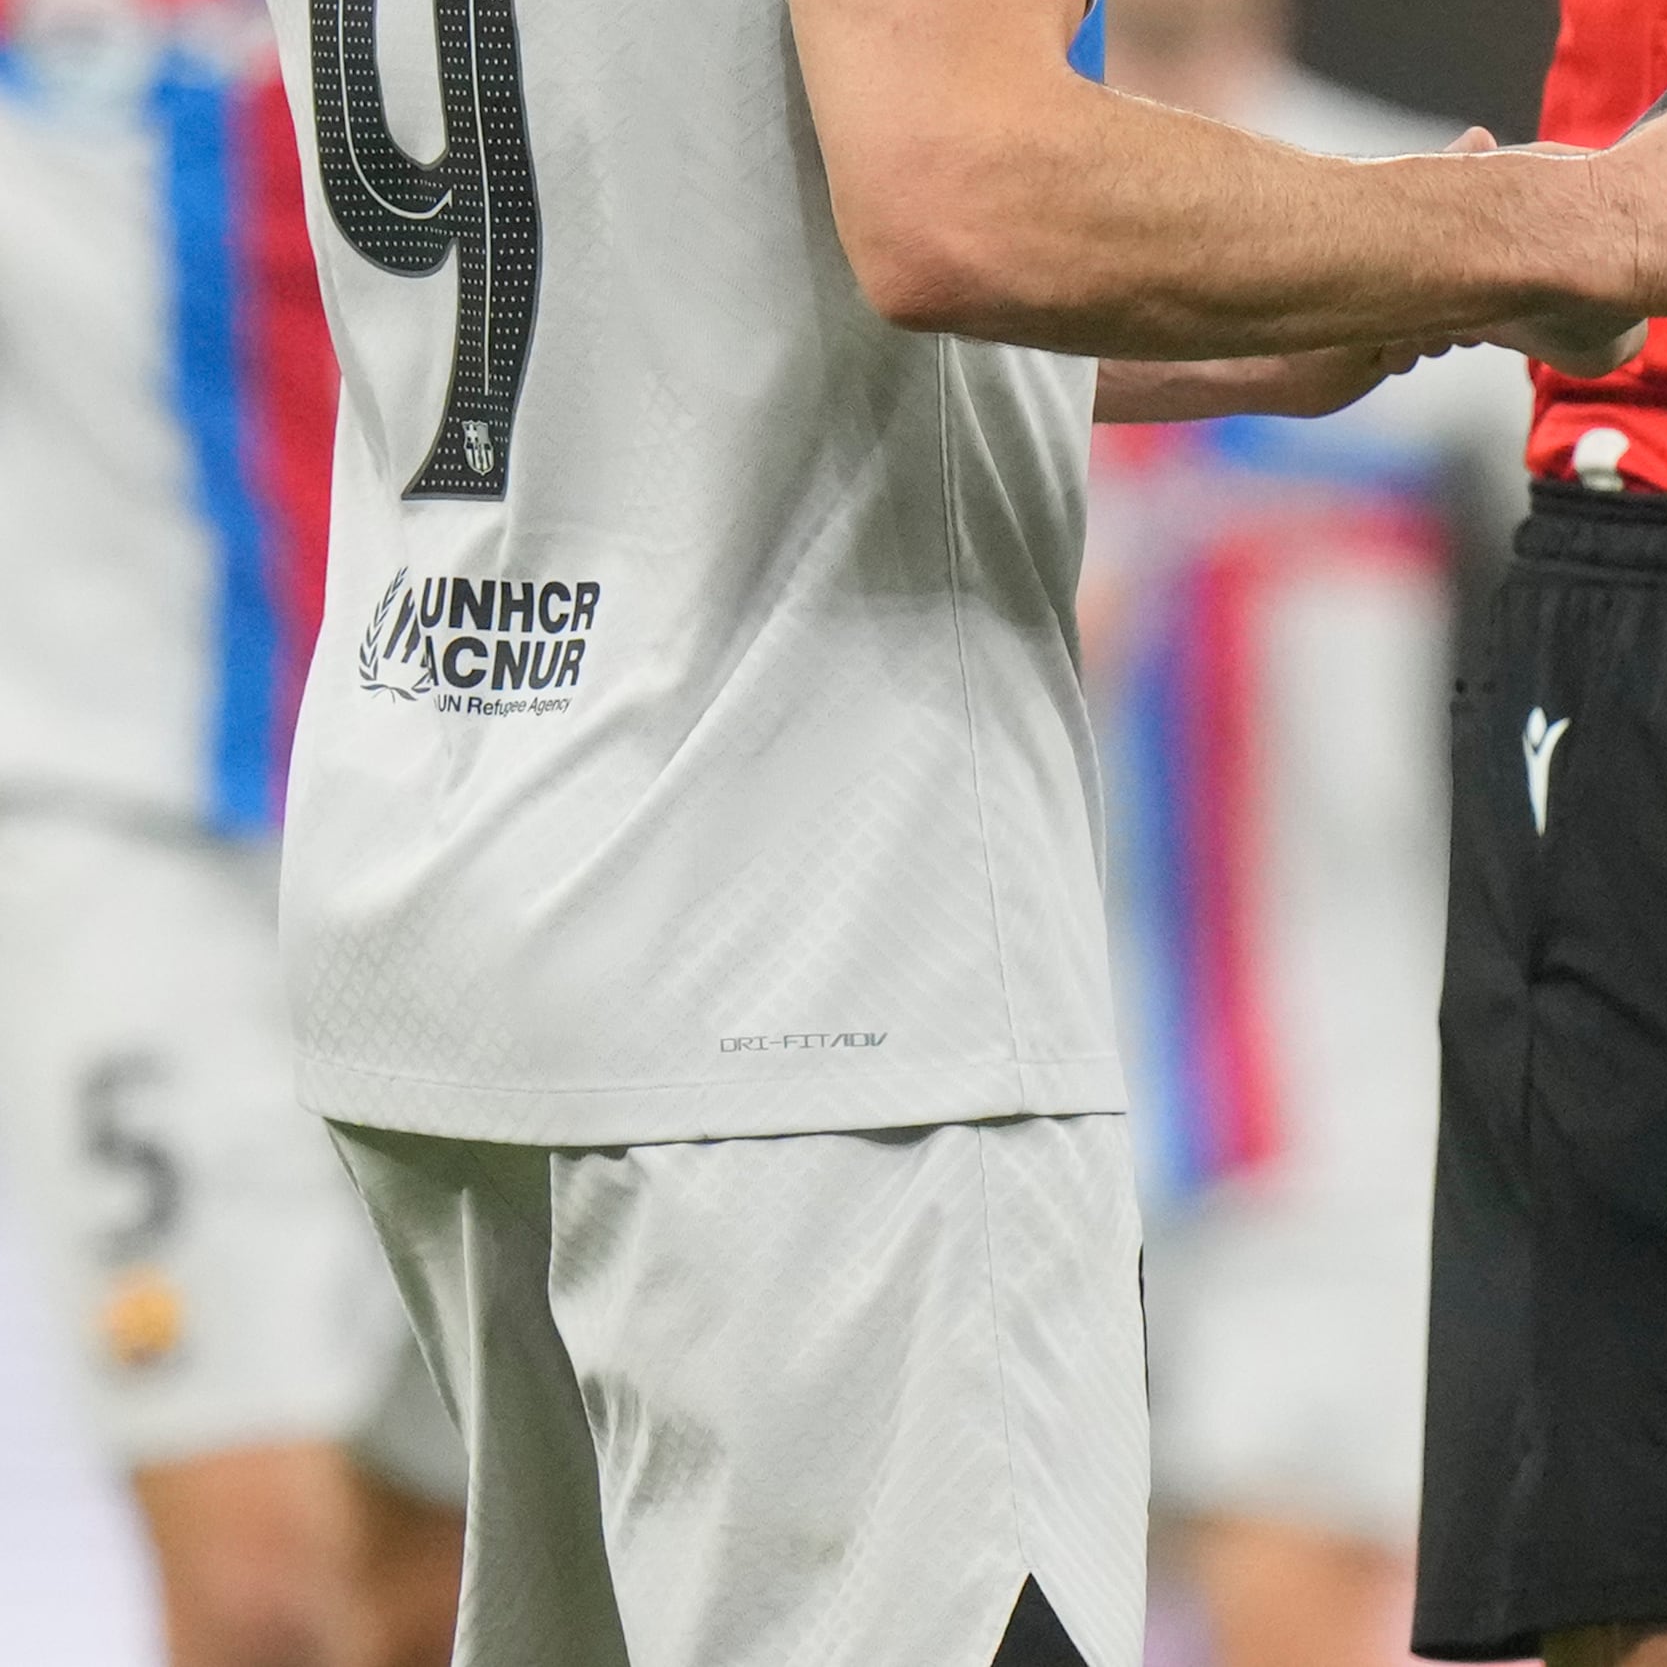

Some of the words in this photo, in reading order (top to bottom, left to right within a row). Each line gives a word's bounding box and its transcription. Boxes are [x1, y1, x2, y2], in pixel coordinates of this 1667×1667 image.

[420, 576, 601, 634] UNHCR
[466, 696, 527, 718] Refugee
[528, 696, 572, 717] Agency
[78, 1046, 184, 1268] 5
